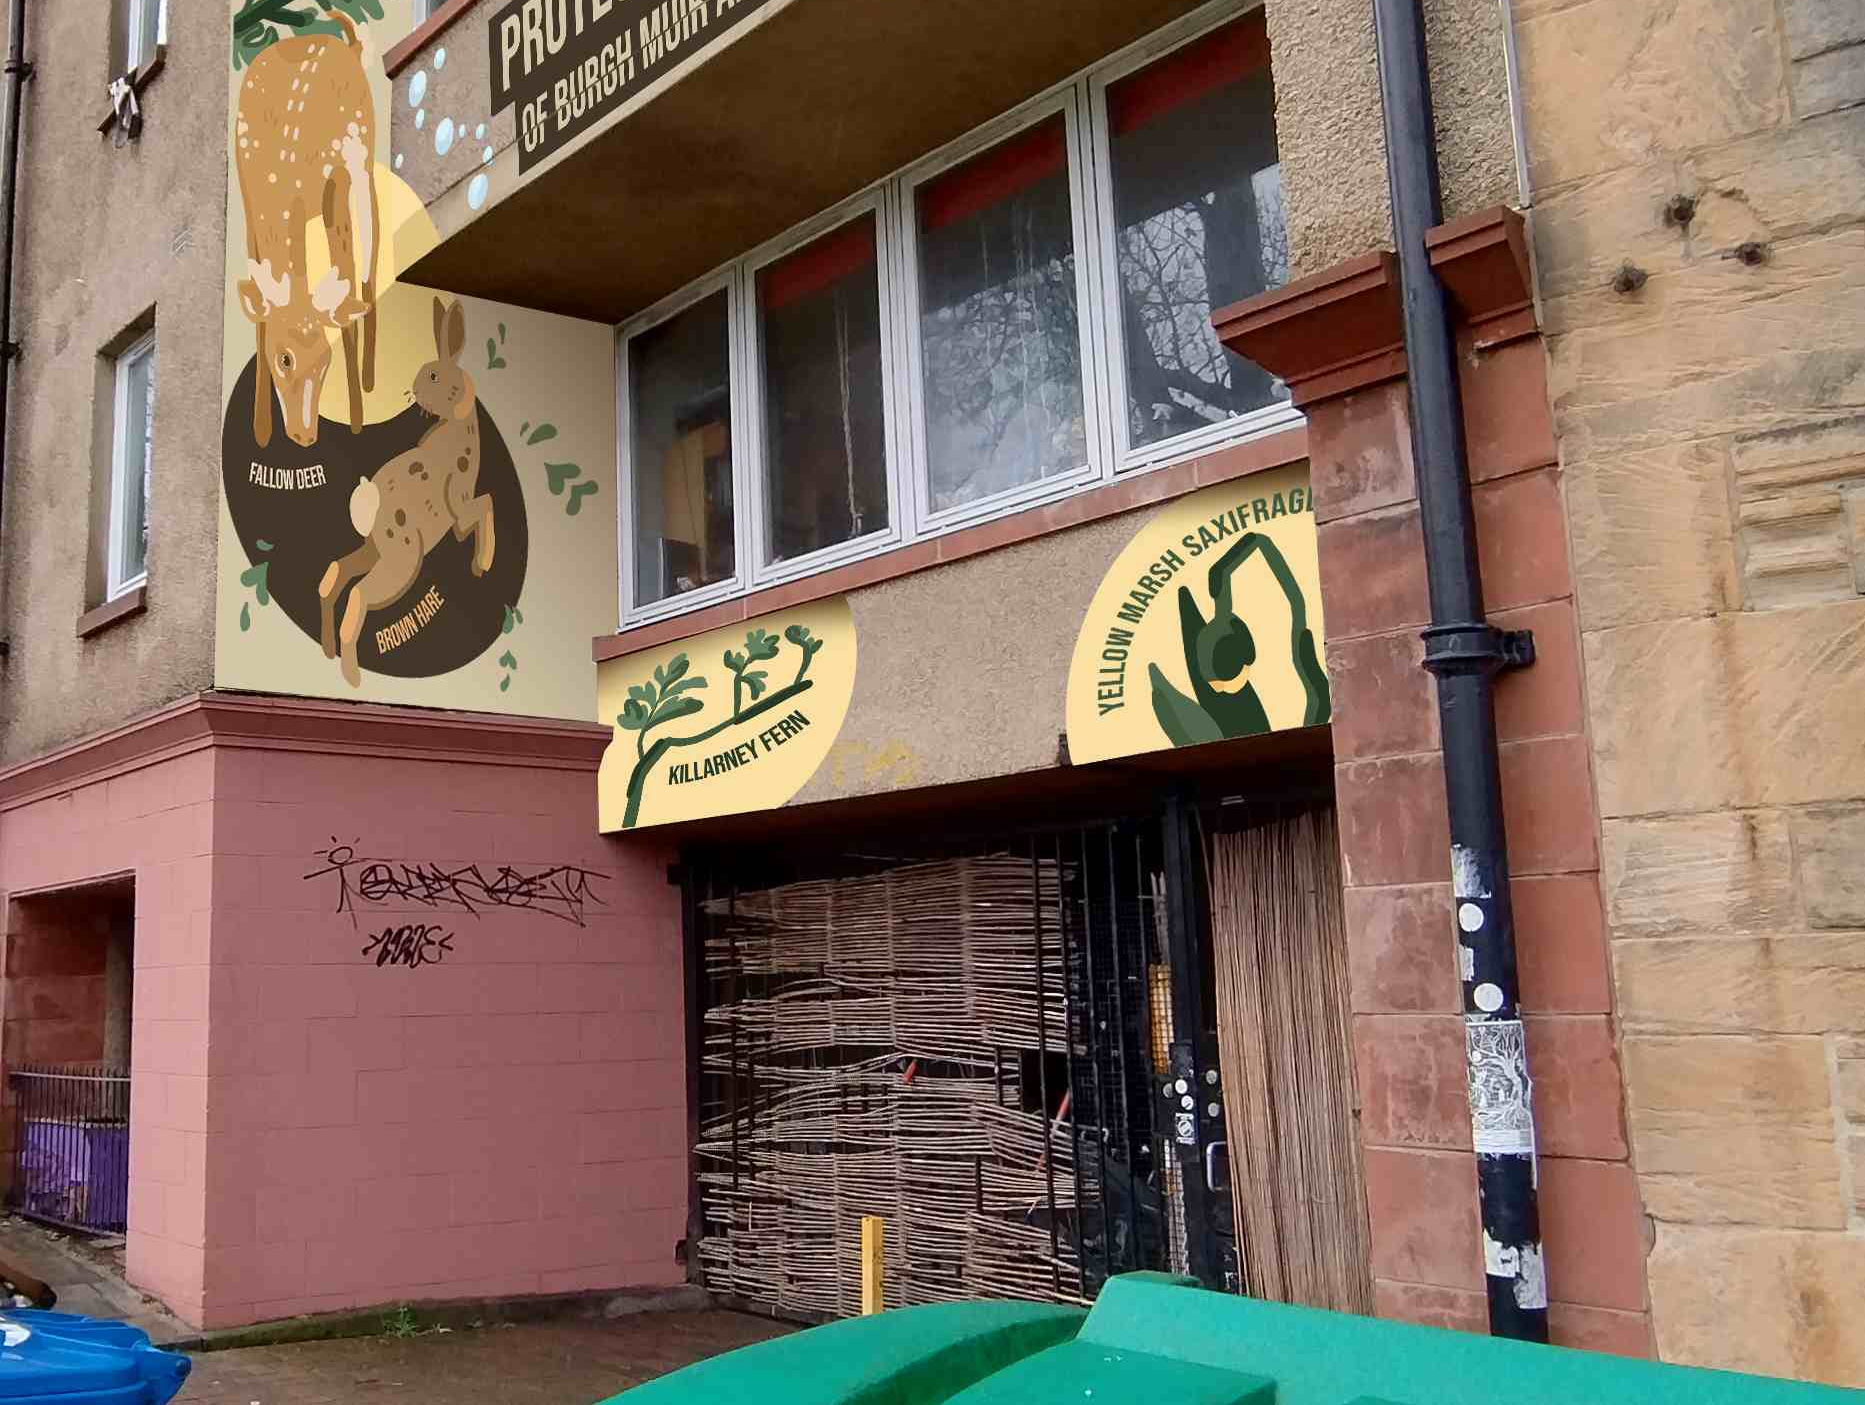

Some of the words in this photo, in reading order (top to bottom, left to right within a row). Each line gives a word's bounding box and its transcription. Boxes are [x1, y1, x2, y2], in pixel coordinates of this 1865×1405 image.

[522, 93, 548, 153] OF
[554, 30, 635, 131] BURGH
[249, 462, 294, 490] FALLOW
[296, 464, 327, 488] DEER
[375, 617, 418, 655] BROWN
[415, 586, 445, 629] HARE
[1097, 626, 1134, 716] YELLOW
[1116, 549, 1186, 624] MARSH
[668, 740, 759, 785] KILLARNEY
[759, 710, 811, 752] FERN
